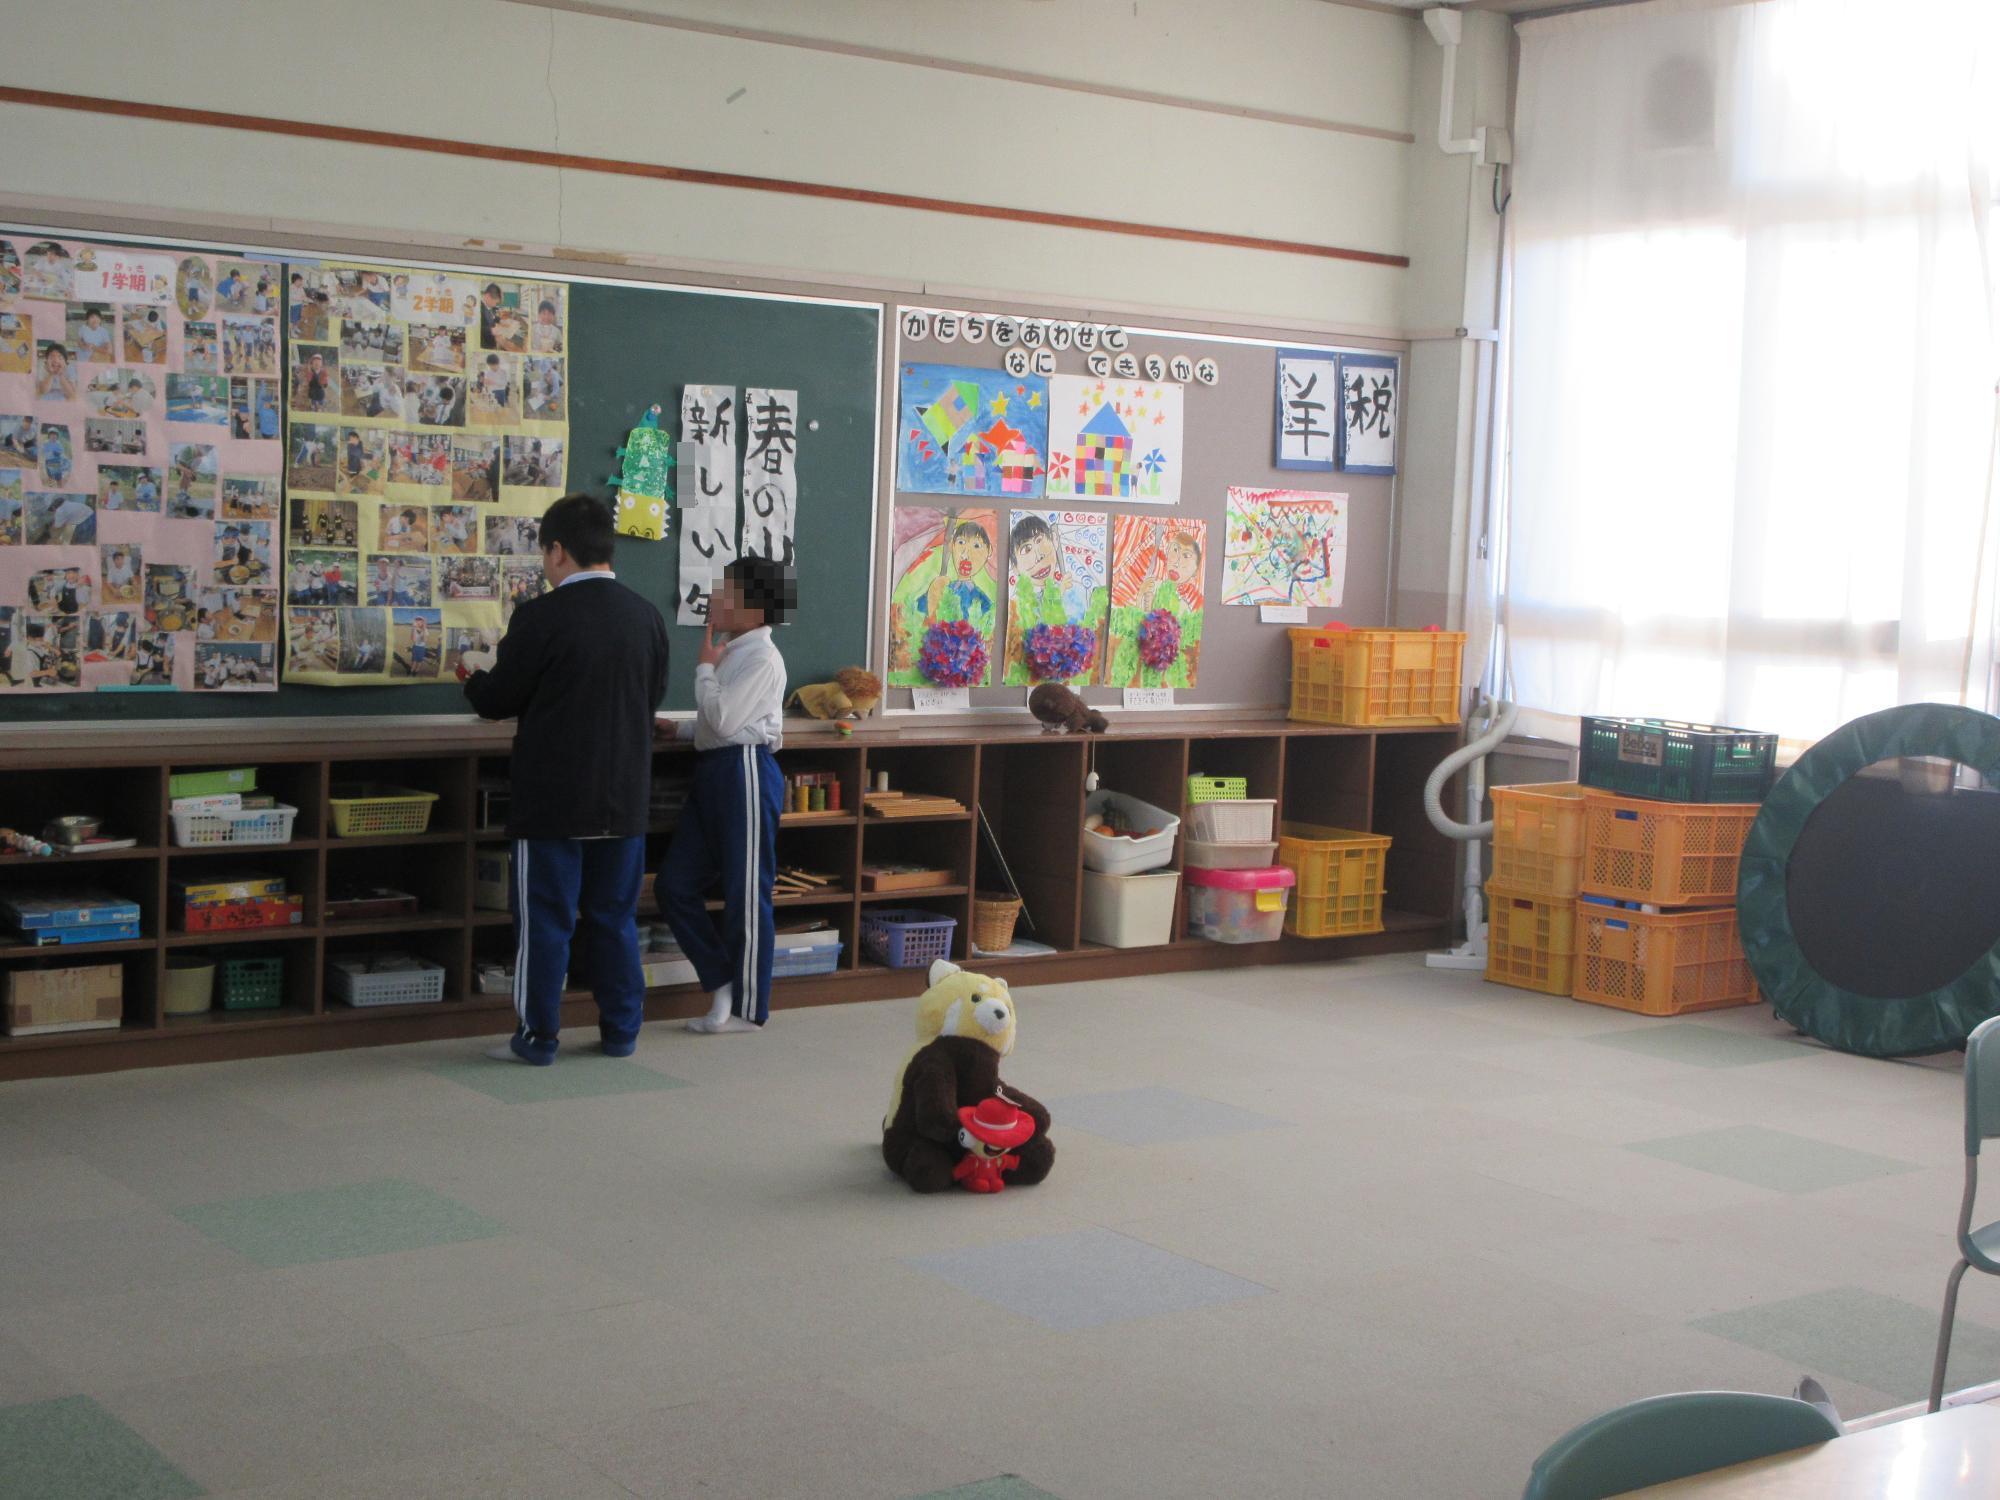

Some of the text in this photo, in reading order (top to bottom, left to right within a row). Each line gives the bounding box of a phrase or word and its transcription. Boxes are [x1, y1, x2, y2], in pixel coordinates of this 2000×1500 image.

[102, 272, 146, 292] 1学期
[413, 295, 454, 314] 2学期
[907, 314, 1125, 348] かたちをあわせて
[1008, 352, 1215, 382] なに できるかな
[1284, 372, 1330, 457] 羊
[1347, 374, 1393, 439] 税
